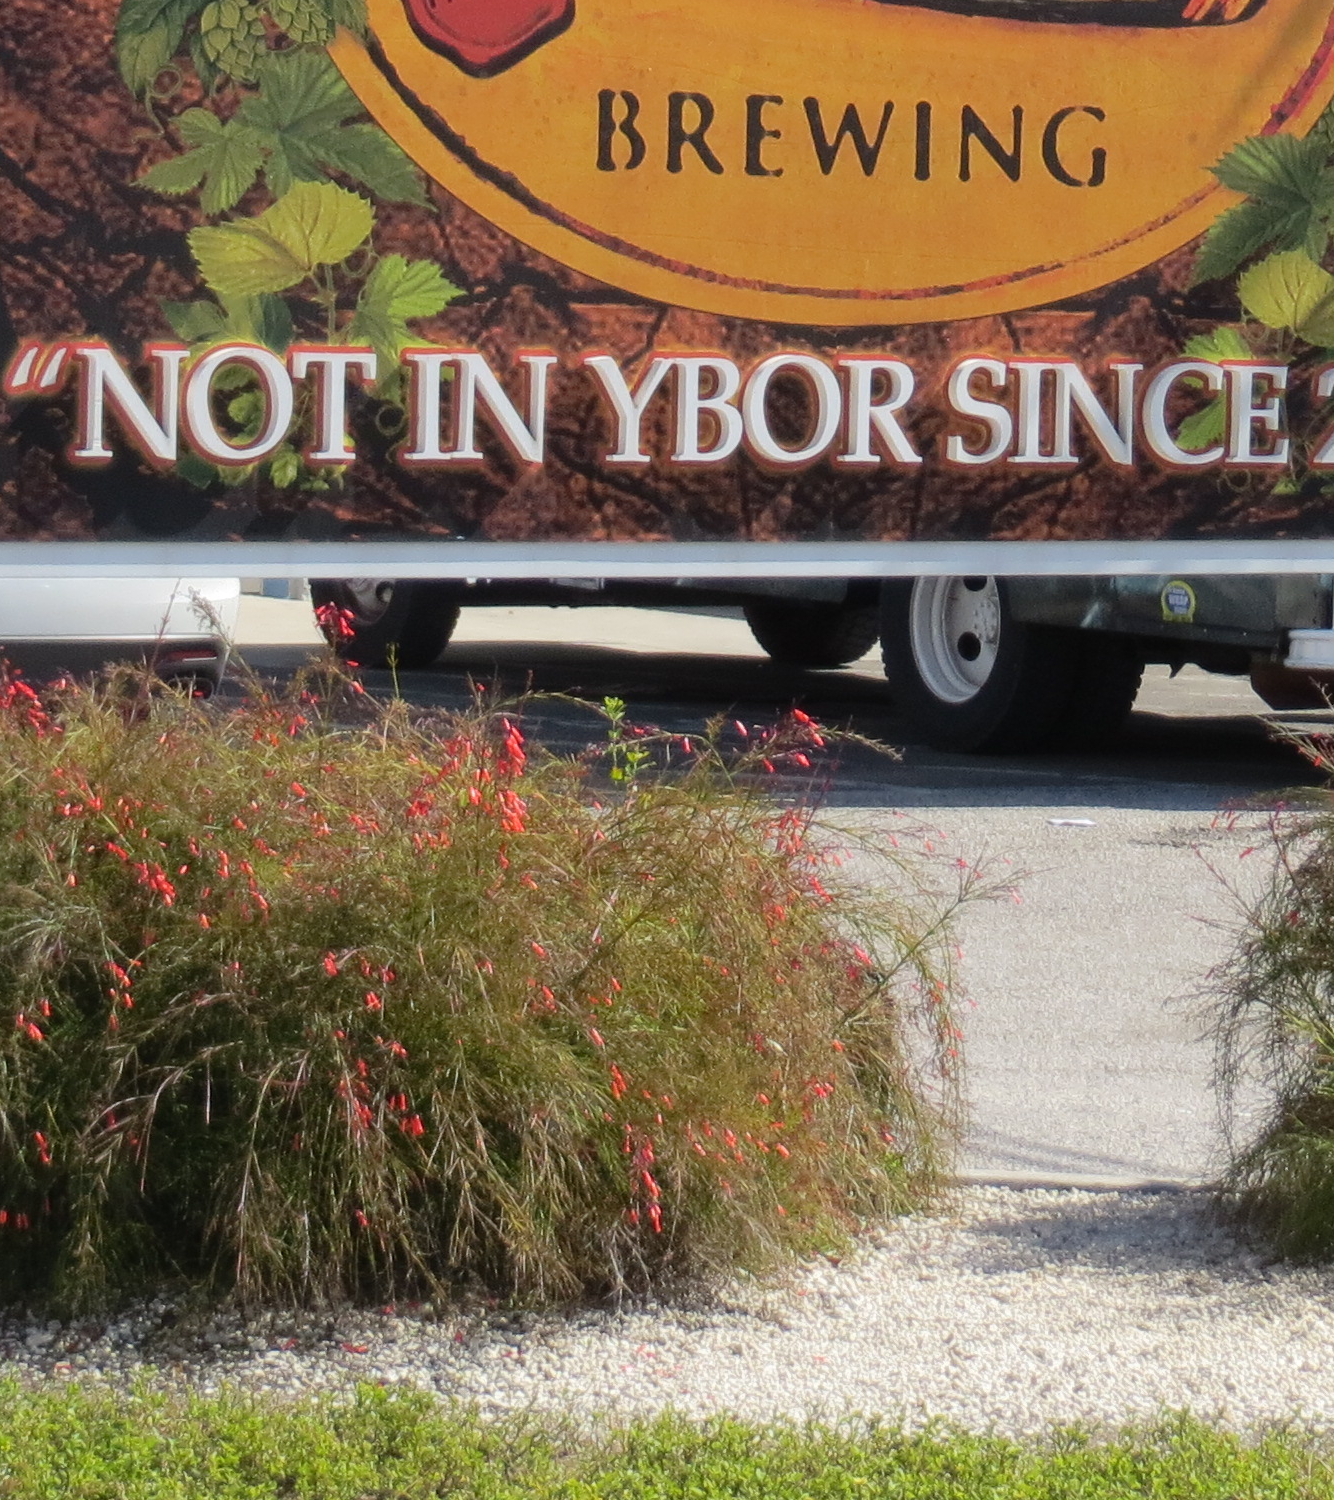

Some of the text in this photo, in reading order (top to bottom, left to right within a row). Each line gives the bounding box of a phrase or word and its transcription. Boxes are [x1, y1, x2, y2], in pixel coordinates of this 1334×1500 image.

[595, 88, 1107, 189] BREWING
[402, 345, 556, 465] IN
[581, 353, 925, 466] YBOR
[947, 357, 1289, 468] SINCE
